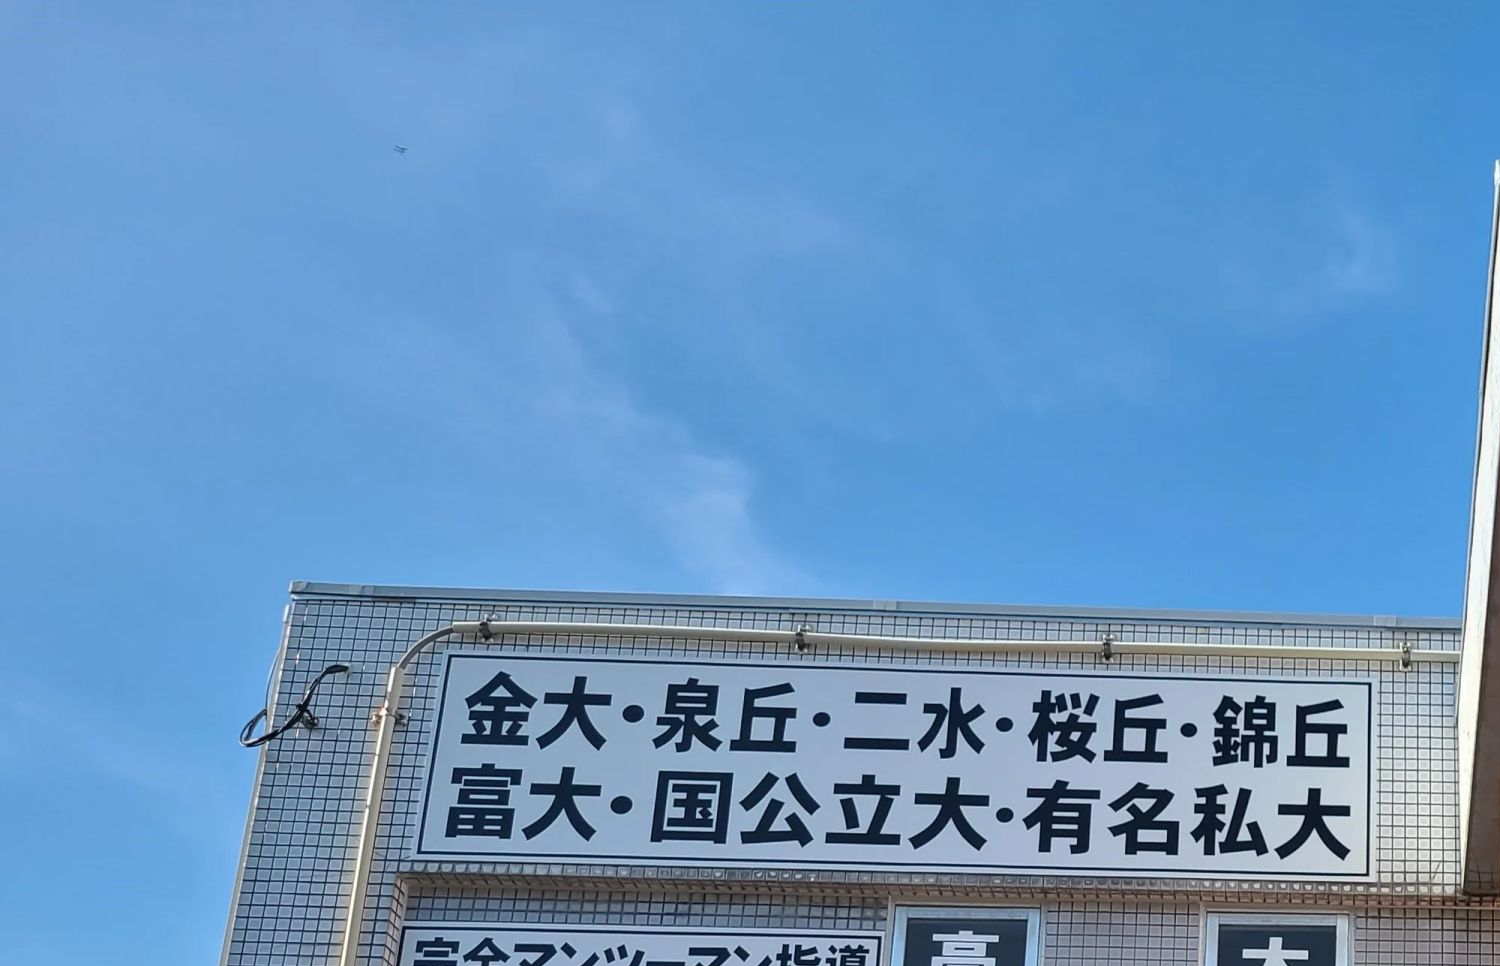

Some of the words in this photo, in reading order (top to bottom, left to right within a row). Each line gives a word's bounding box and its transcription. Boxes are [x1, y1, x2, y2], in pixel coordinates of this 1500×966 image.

[461, 671, 1351, 769] 金大・泉丘・二水・桜丘・錦丘
[445, 764, 1351, 861] 富大・国公立大・有名私大
